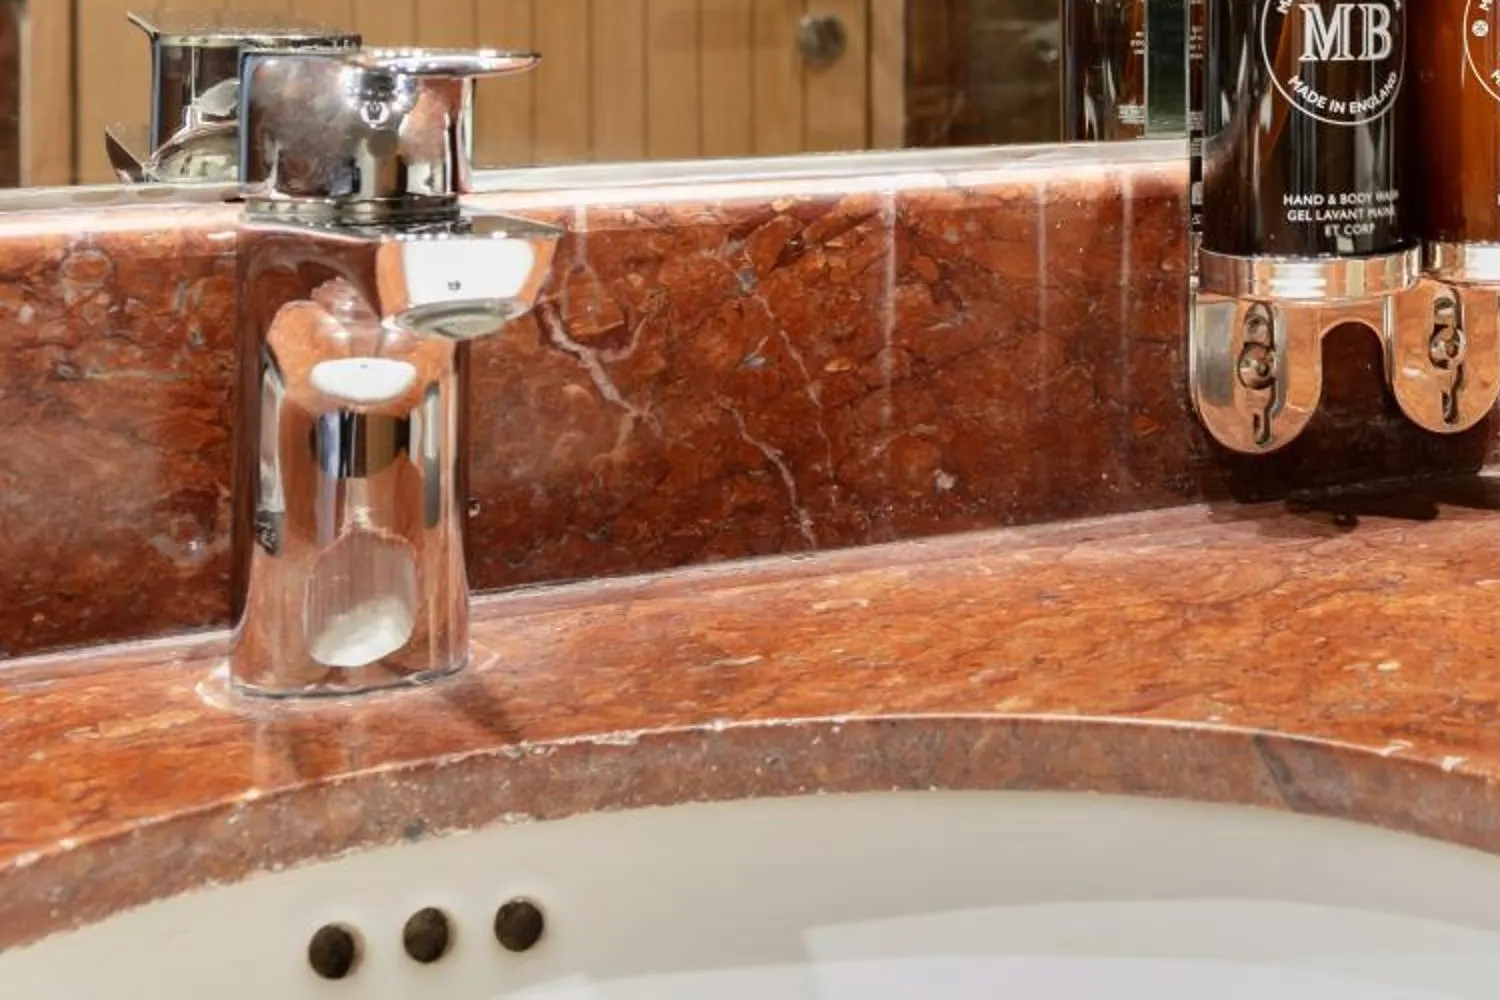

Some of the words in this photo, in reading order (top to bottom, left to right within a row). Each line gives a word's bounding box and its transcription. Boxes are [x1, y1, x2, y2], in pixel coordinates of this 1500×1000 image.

[1298, 3, 1393, 61] MB
[1287, 74, 1327, 109] MADE
[1329, 99, 1345, 114] IN
[1349, 71, 1397, 114] ENGLAND
[1283, 193, 1324, 206] HAND
[1327, 193, 1337, 206] &
[1339, 191, 1373, 206] BODY
[1287, 209, 1312, 222] GEL
[1316, 206, 1365, 221] LAVANT
[1324, 223, 1340, 238] ET
